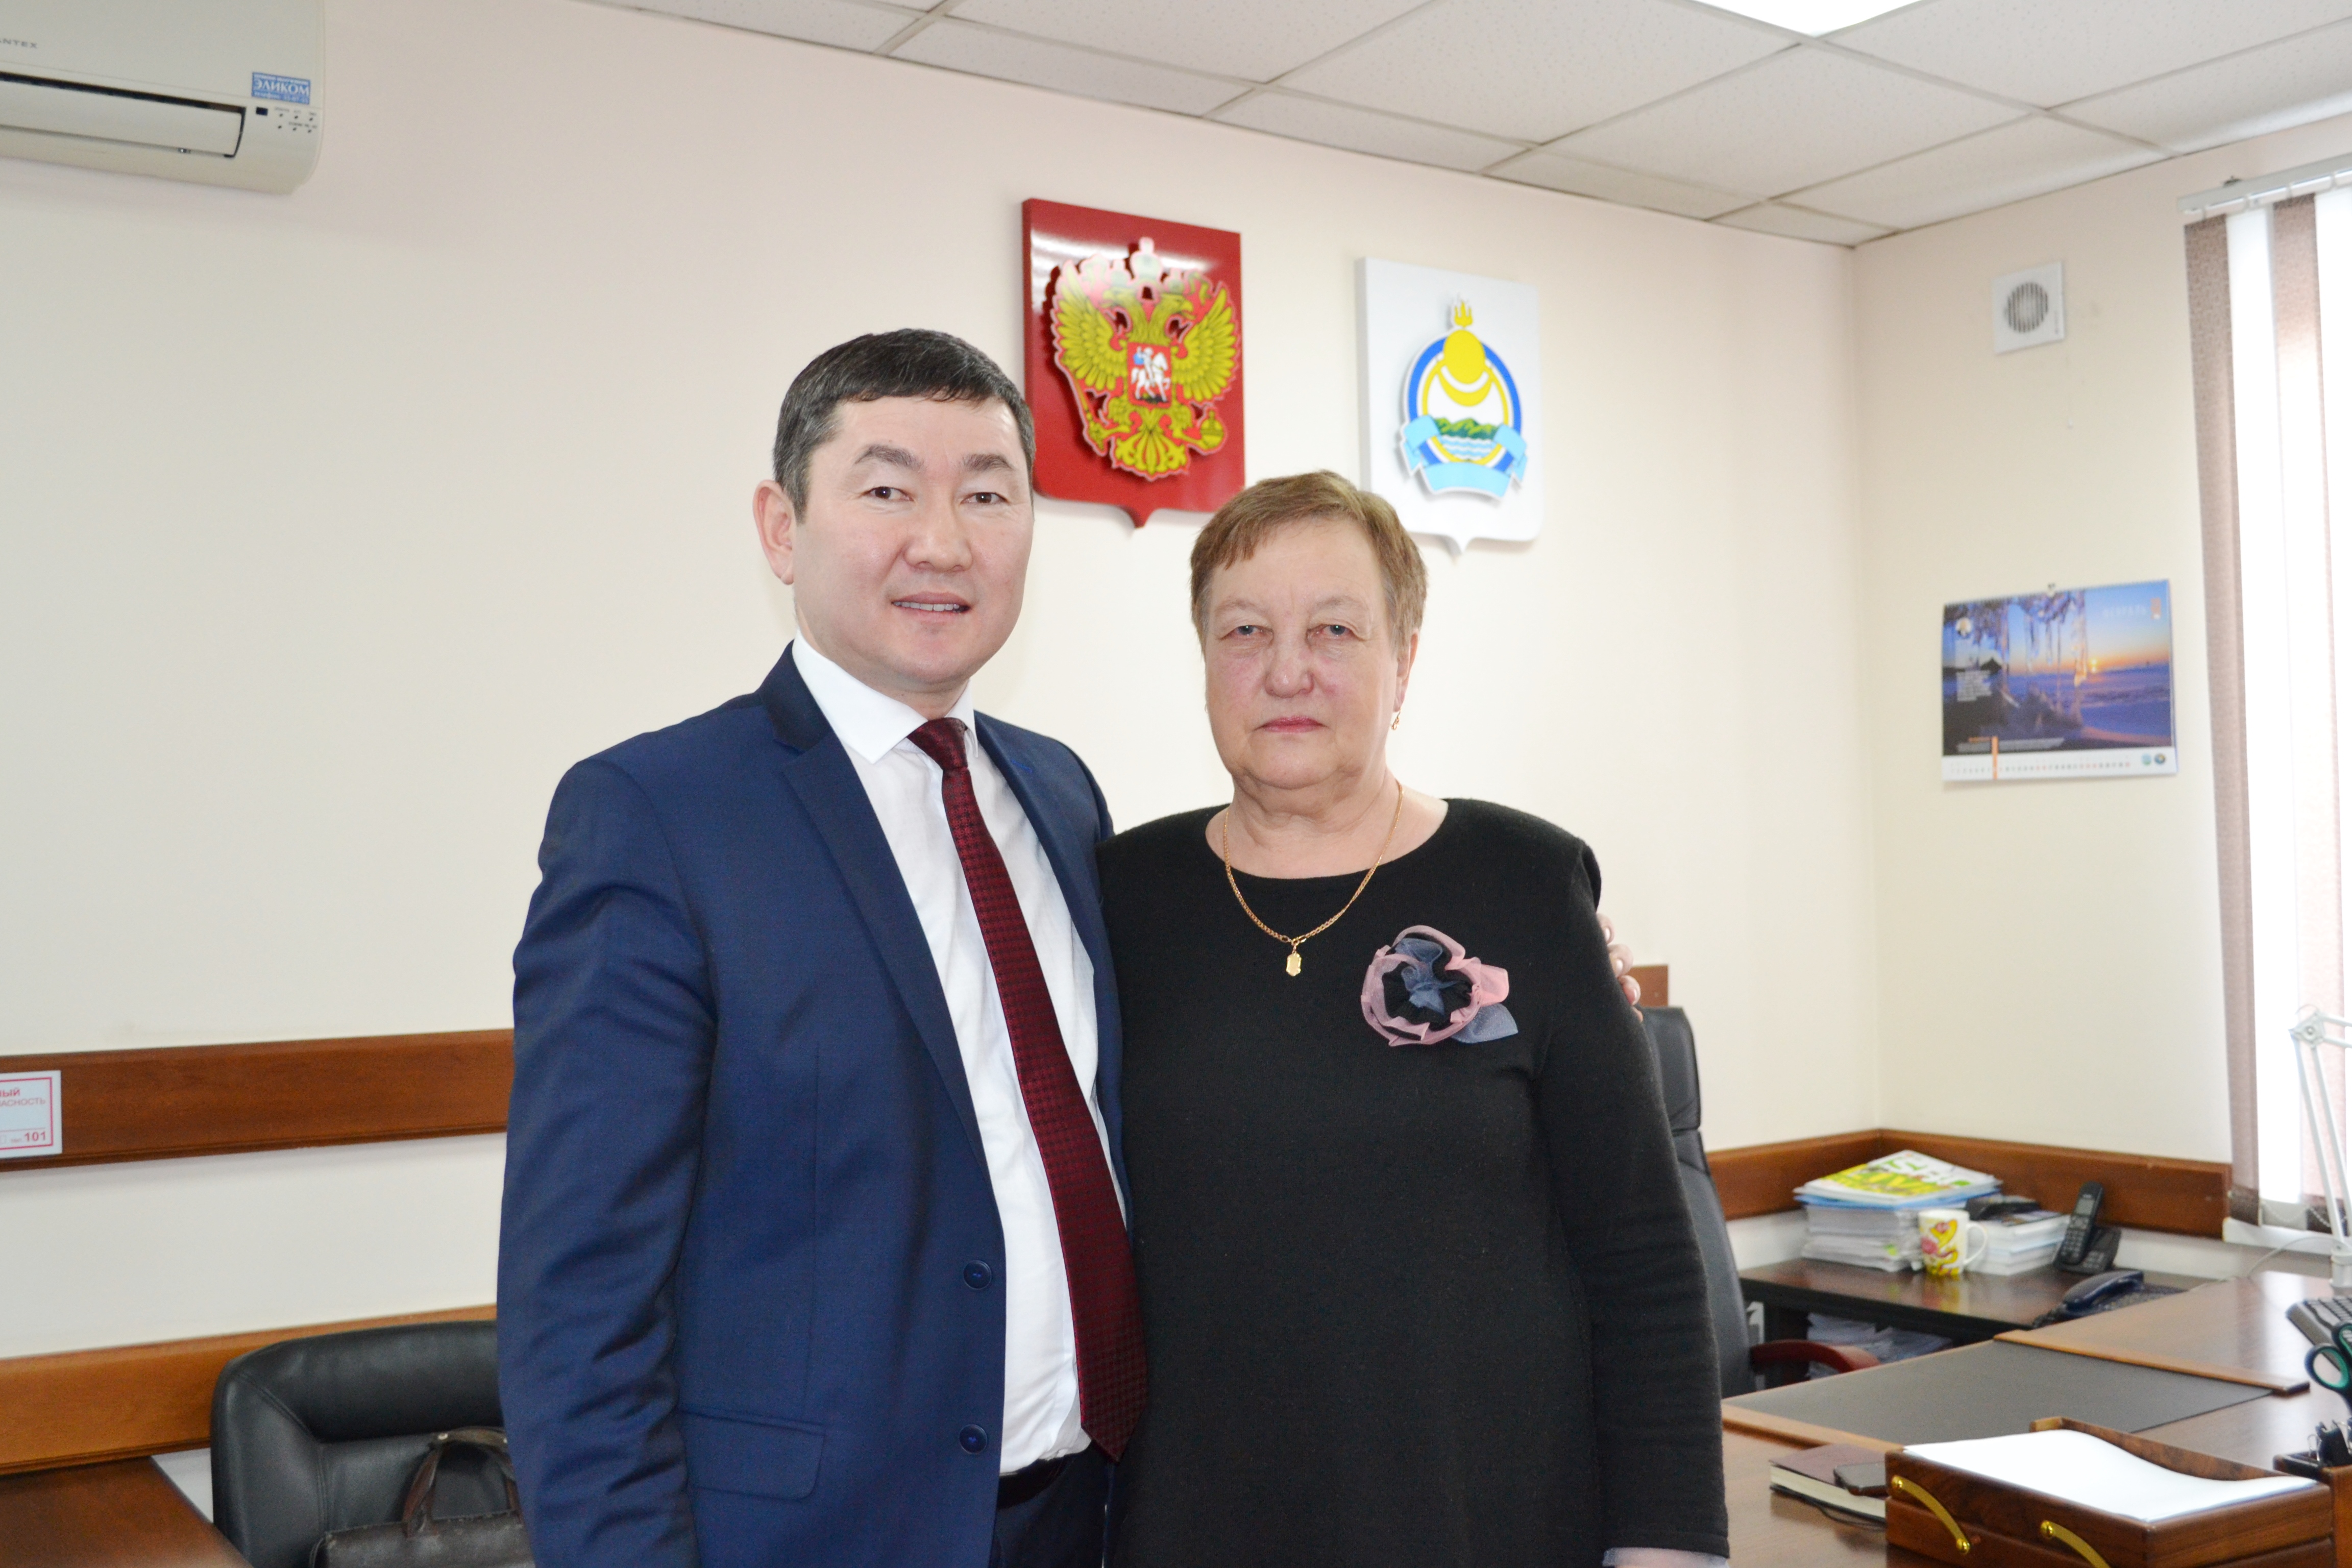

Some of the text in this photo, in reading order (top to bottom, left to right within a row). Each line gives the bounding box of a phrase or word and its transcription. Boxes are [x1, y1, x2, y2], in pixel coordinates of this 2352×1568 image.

[0, 38, 37, 48] NTEX
[253, 79, 309, 96] ЭЛИКОМ
[0, 1088, 20, 1096] ЫЙ
[0, 1098, 46, 1106] АСНОСТЬ
[24, 1131, 46, 1141] 101
